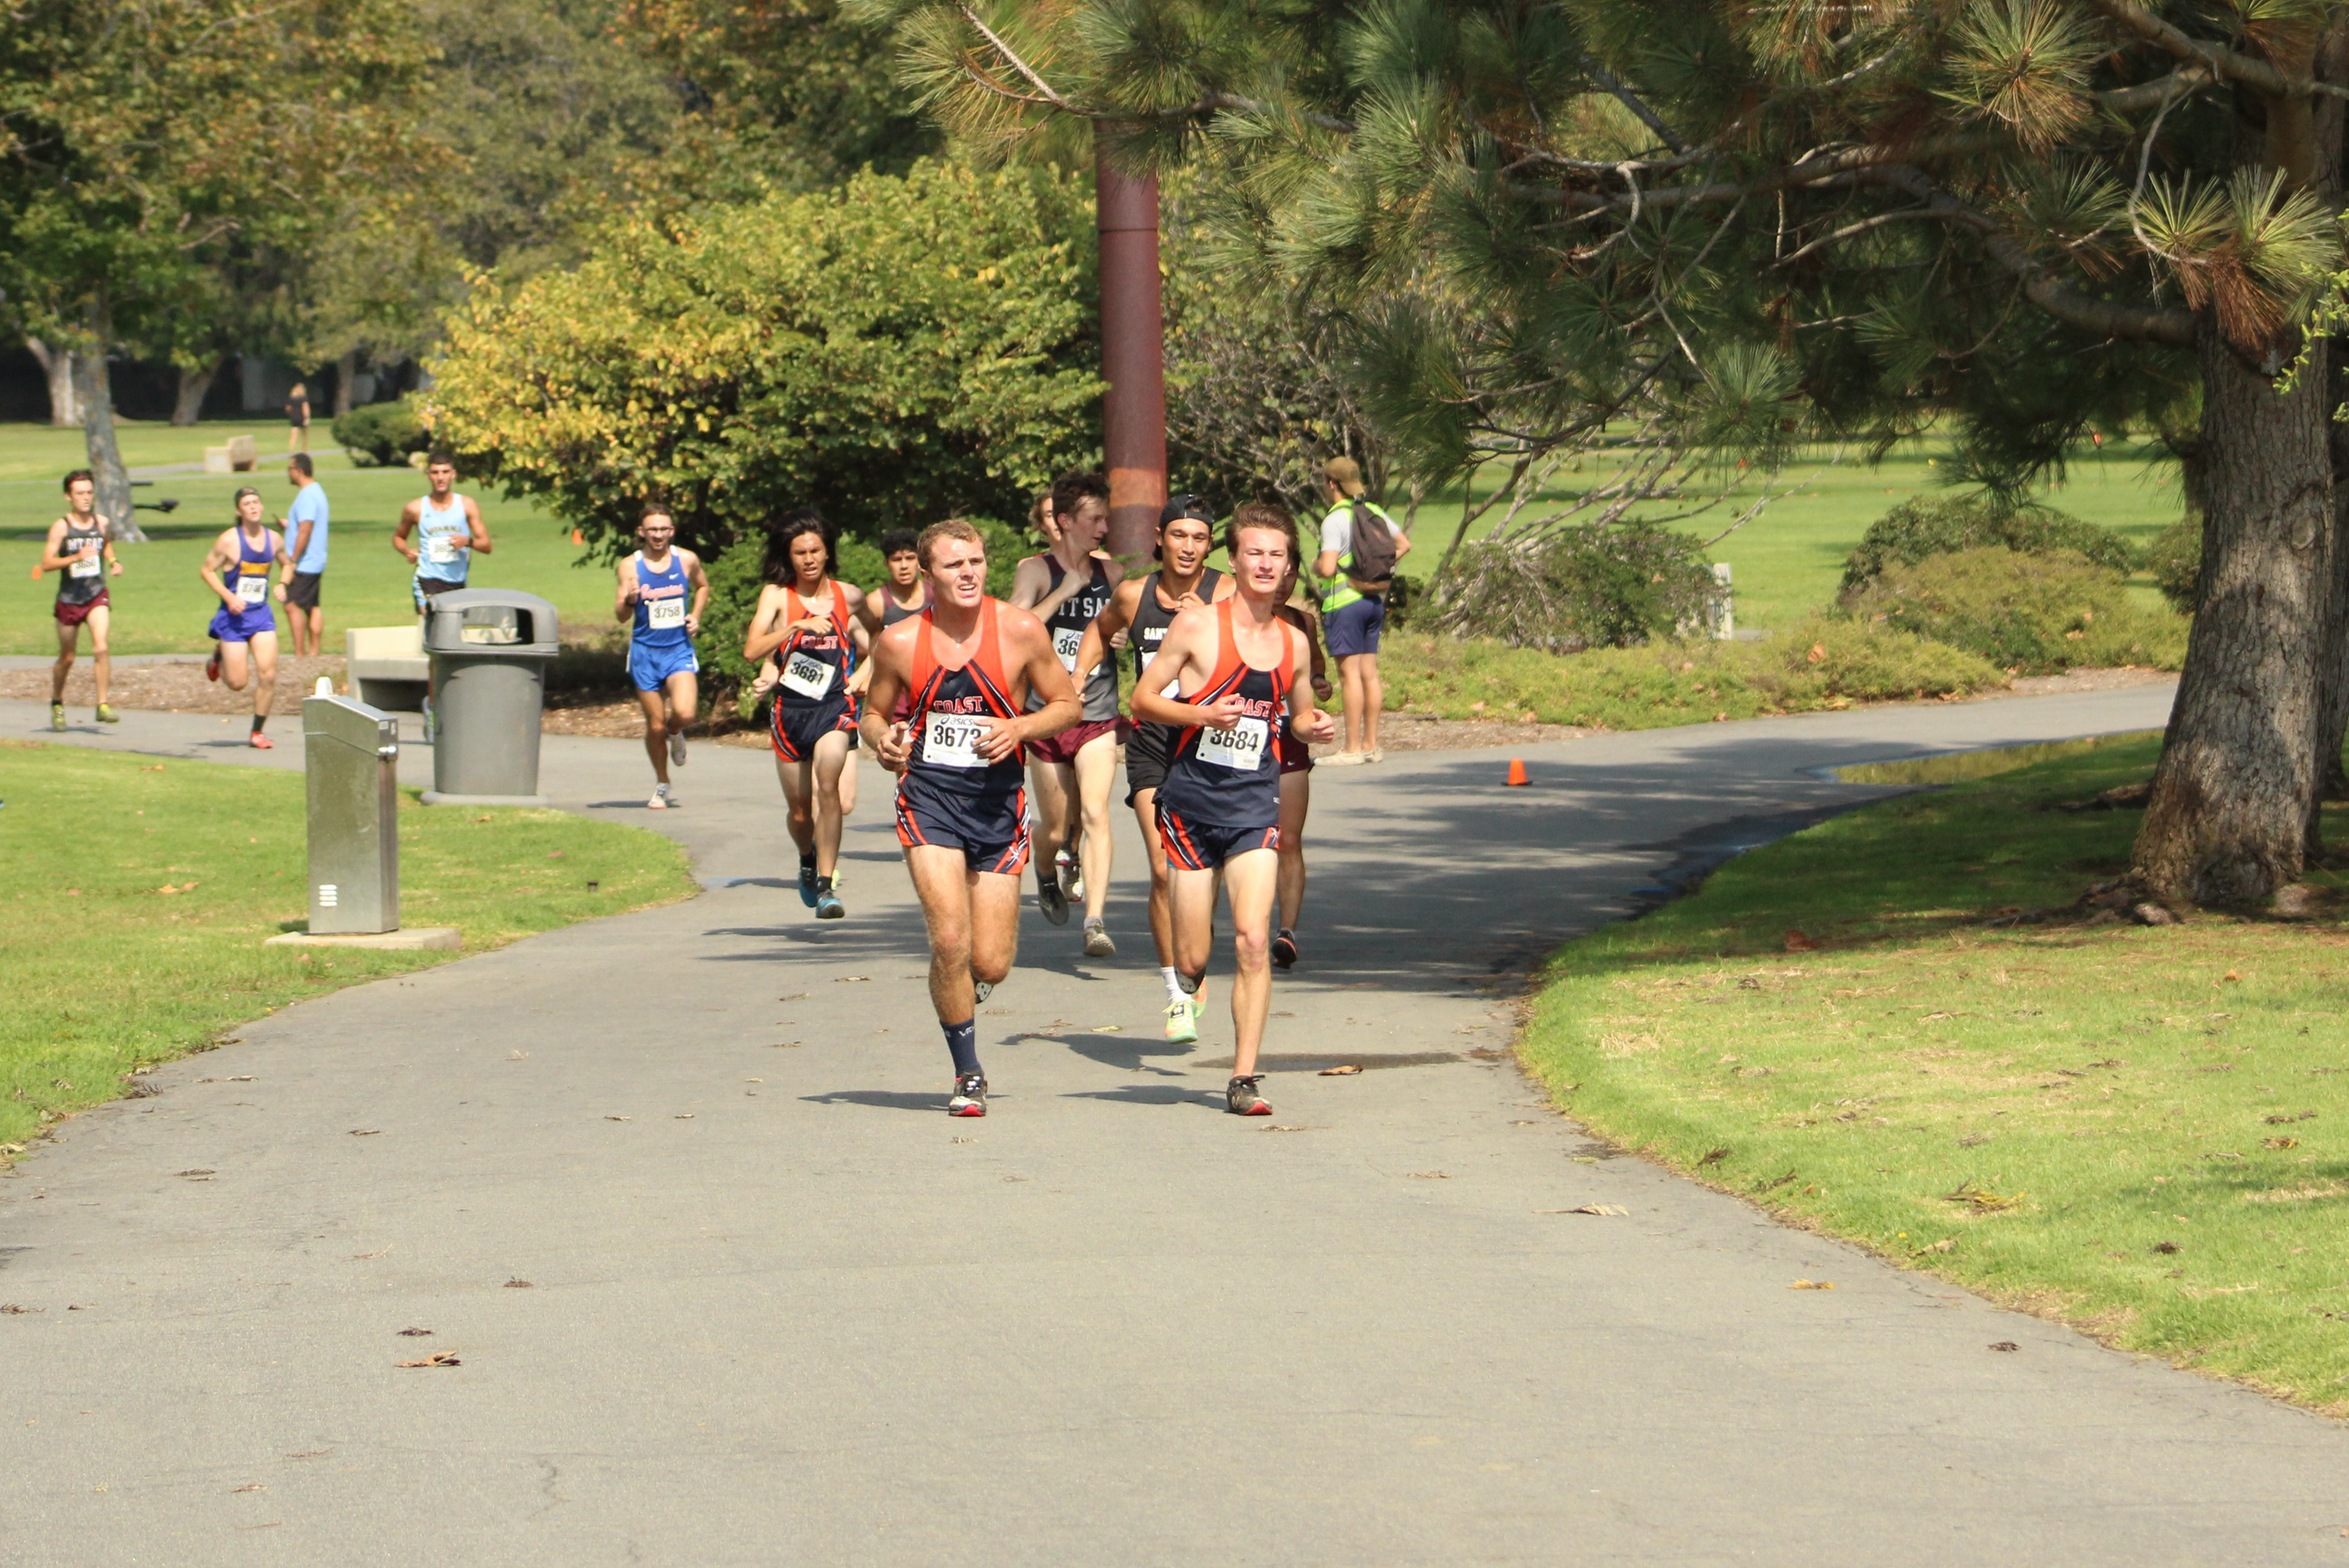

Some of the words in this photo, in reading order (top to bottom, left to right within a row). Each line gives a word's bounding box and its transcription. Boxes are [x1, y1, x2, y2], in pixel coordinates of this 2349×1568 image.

[654, 605, 681, 619] 3758
[800, 635, 839, 650] COAST
[790, 662, 825, 686] 3681
[933, 696, 983, 715] COAST
[1209, 727, 1260, 752] 3684
